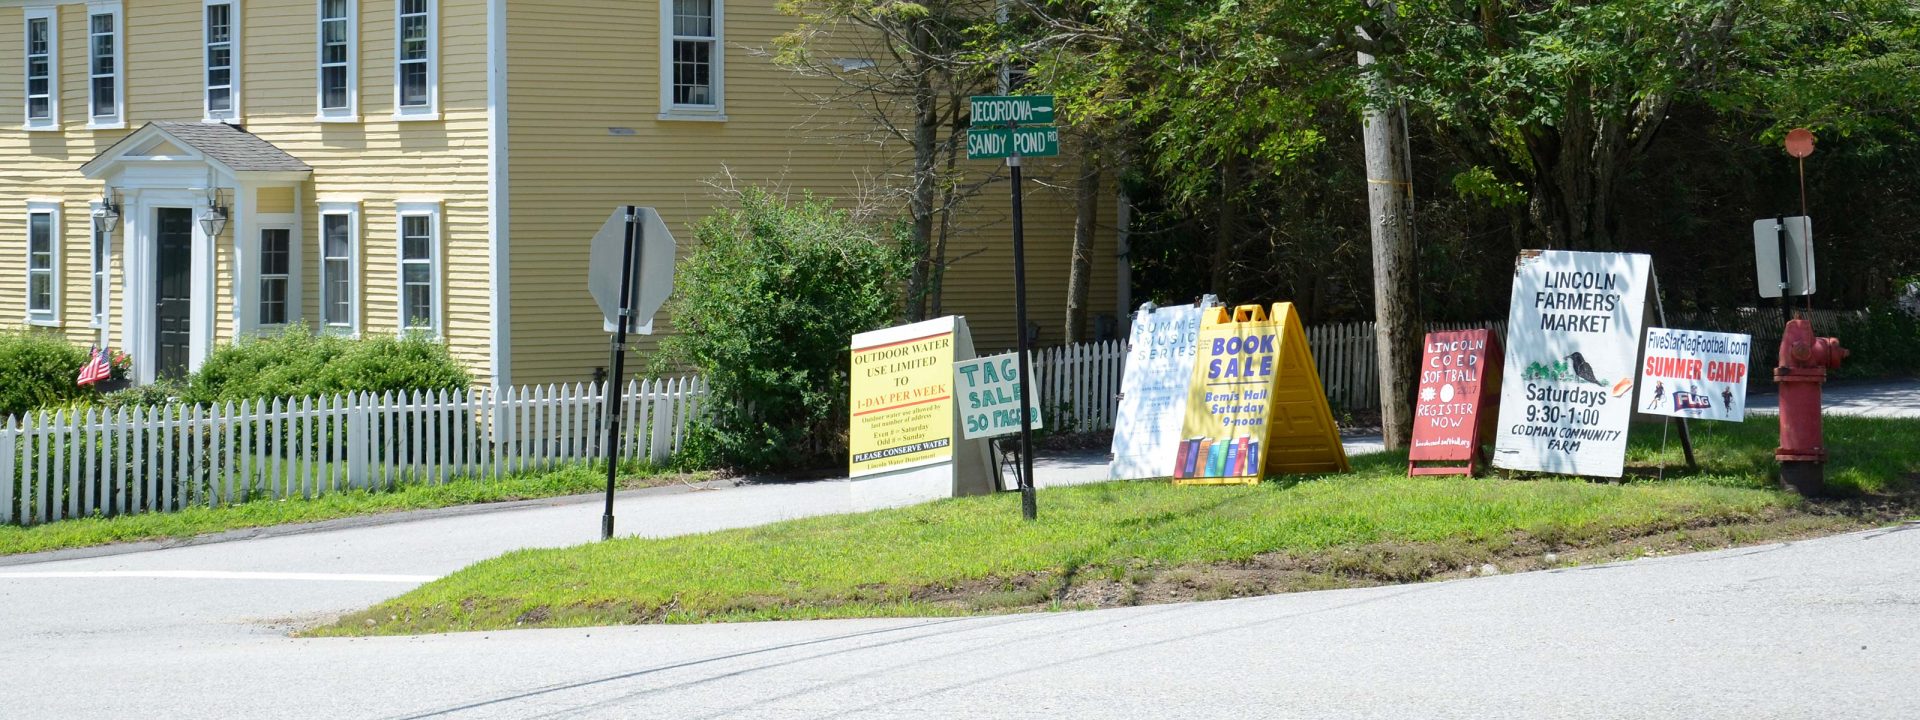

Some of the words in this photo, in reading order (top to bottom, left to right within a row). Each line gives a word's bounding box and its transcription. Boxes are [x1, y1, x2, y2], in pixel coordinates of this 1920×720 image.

[971, 100, 1033, 122] DECORDOVA
[968, 134, 1007, 155] SANDY
[1013, 132, 1045, 153] POND
[1047, 131, 1057, 142] RD
[1544, 271, 1616, 290] LINCOLN
[1535, 292, 1621, 311] FARMERS'
[1137, 319, 1196, 335] SUMME
[1540, 313, 1611, 333] MARKET
[1144, 332, 1196, 347] MUSIC
[1211, 334, 1275, 356] BOOK
[1427, 340, 1483, 354] LINCOLN
[1648, 331, 1748, 356] FiveStarFlagFootball.com
[854, 347, 909, 365] OUTDOOR
[912, 338, 949, 353] WATER
[1139, 345, 1196, 361] SERIES
[867, 365, 887, 378] USE
[890, 355, 937, 373] LIMITED
[1208, 356, 1273, 379] SALE
[1430, 355, 1477, 368] COED
[1645, 355, 1703, 381] SUMMER
[1706, 360, 1746, 384] CAMP
[894, 376, 909, 387] TO
[959, 358, 1017, 387] TAG
[1422, 369, 1477, 384] SOFTBALL
[857, 395, 887, 409] 1-DAY
[889, 390, 910, 403] PER
[913, 383, 946, 398] WEEK
[1205, 391, 1240, 403] Bemis
[1244, 389, 1267, 401] Hall
[1526, 383, 1607, 407] Saturdays
[1679, 392, 1709, 406] FLAG
[1211, 402, 1264, 415] Saturday
[1417, 403, 1473, 417] REGISTER
[1526, 405, 1599, 426] 9:30-1:00
[901, 423, 929, 434] Saturday
[967, 413, 988, 433] 50
[1223, 416, 1263, 427] 9-noon
[1431, 417, 1463, 428] NOW
[902, 432, 925, 442] Sunday
[1511, 424, 1558, 438] CODMAN
[1559, 427, 1621, 441] COMMUNITY
[855, 450, 883, 462] PLEASE
[883, 443, 921, 456] CONSERVE
[923, 439, 948, 450] WATER
[1547, 439, 1581, 455] FARM
